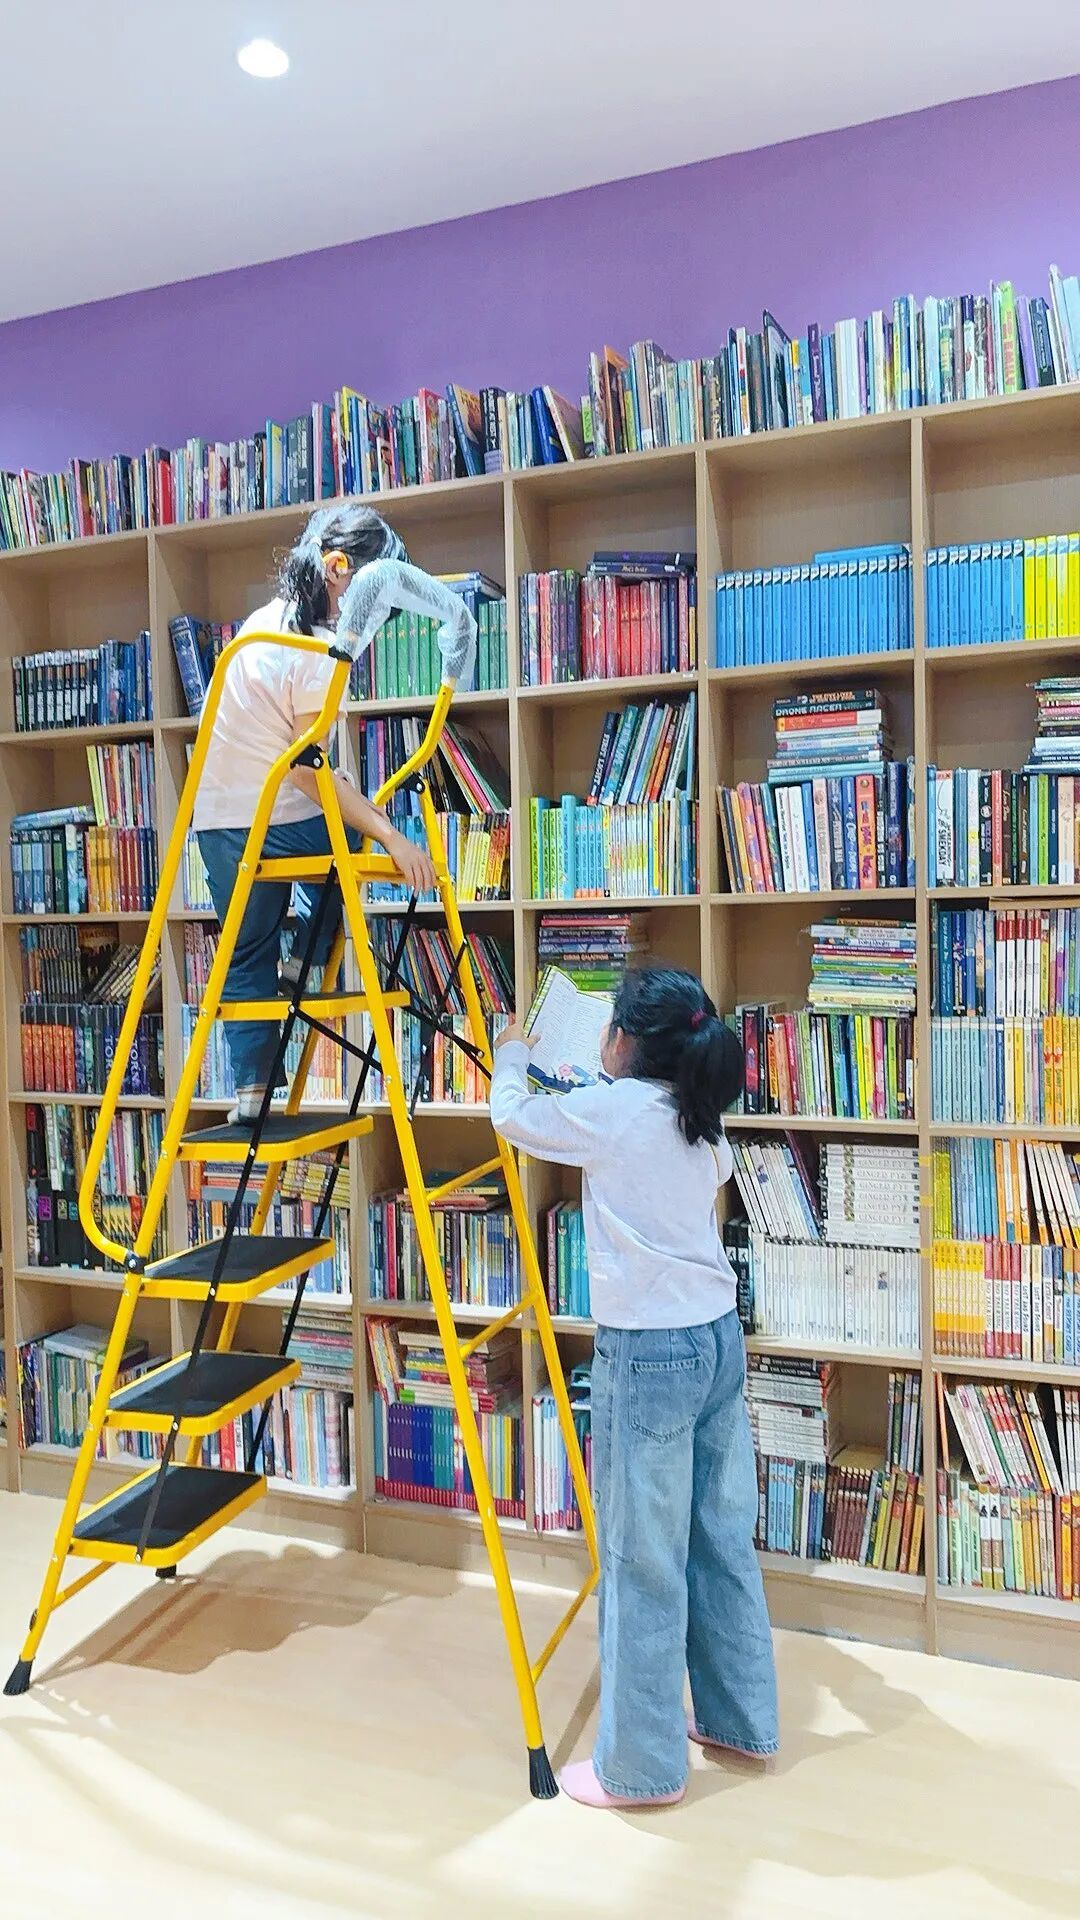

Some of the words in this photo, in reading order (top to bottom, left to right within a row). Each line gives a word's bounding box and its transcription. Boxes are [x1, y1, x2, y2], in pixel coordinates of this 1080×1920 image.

[938, 829, 946, 866] SMEKDAY
[104, 1035, 114, 1075] TOR
[130, 1039, 141, 1088] TORN
